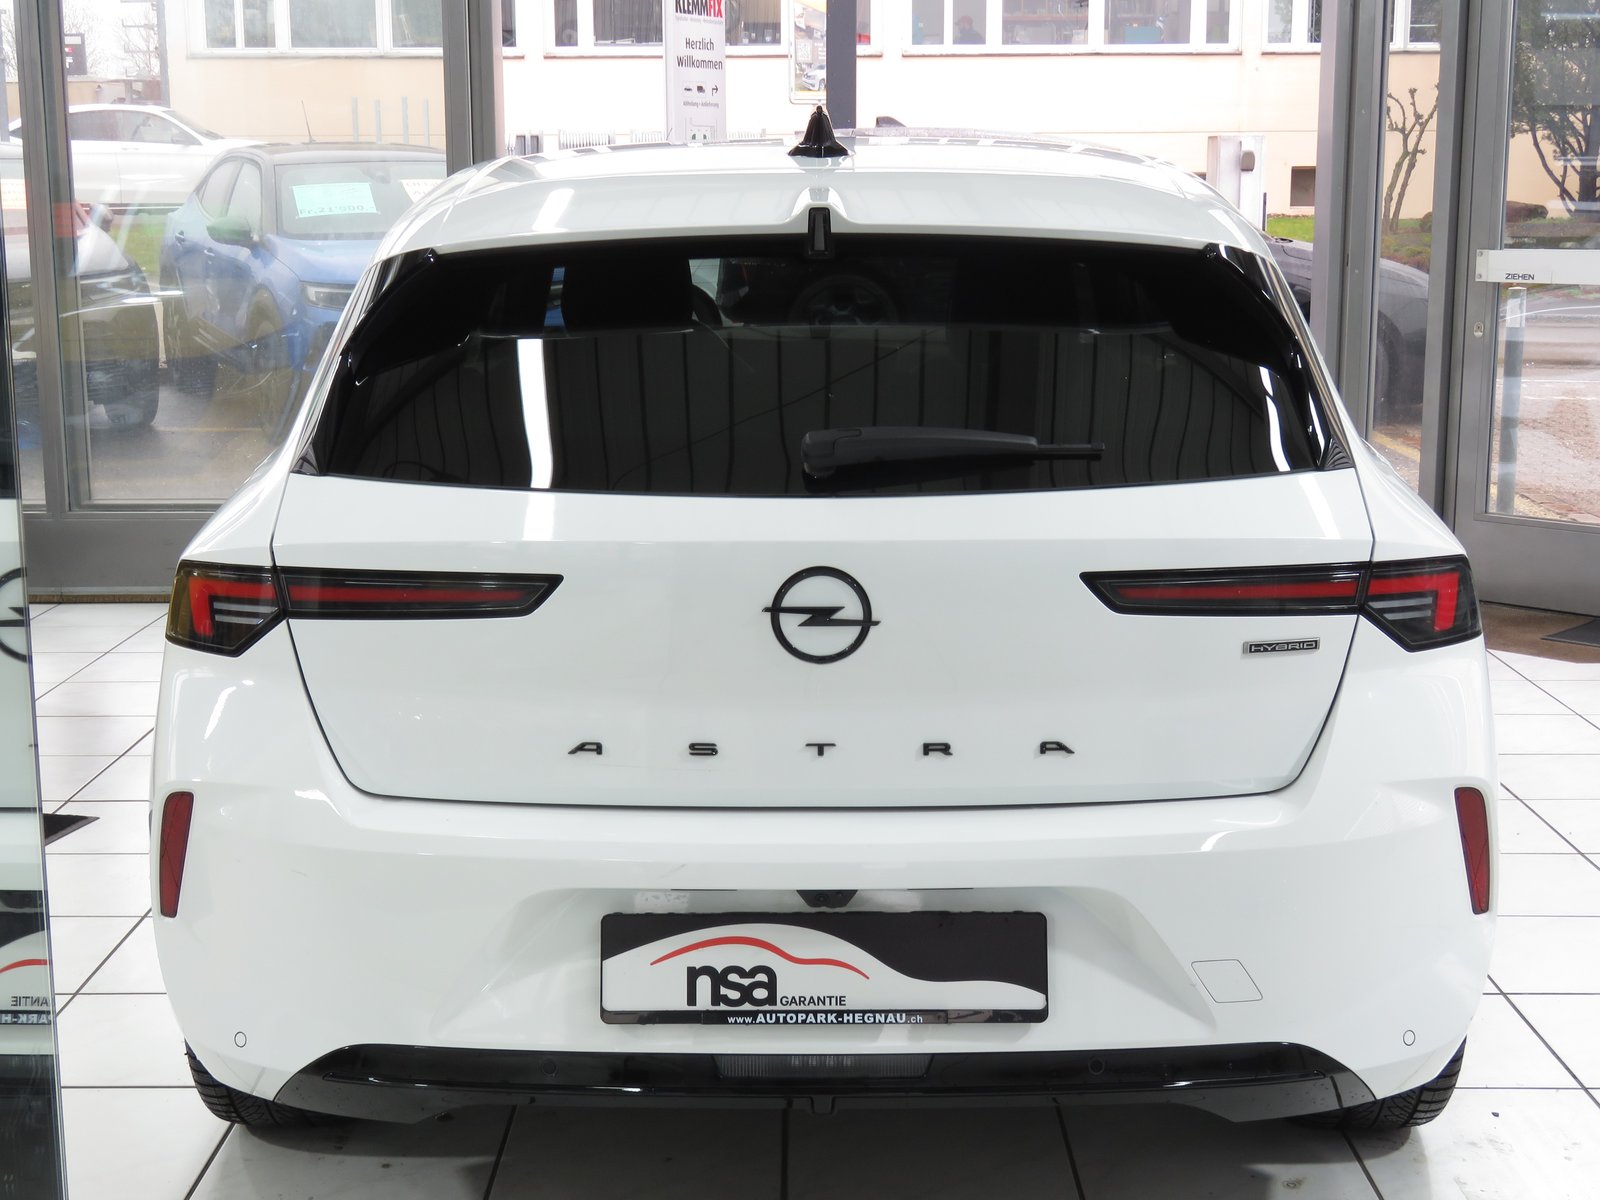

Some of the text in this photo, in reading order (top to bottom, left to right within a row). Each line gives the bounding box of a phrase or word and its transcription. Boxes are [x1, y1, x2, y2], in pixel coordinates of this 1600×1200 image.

[674, 0, 723, 18] KLEMMFIX
[685, 37, 715, 51] Herzlich
[676, 55, 723, 70] Willkommen
[1504, 273, 1535, 281] ZIEHEN
[1250, 641, 1316, 652] HYBRID
[568, 741, 1075, 756] ASTRA
[686, 965, 778, 1008] nsa
[779, 995, 847, 1007] GARANTIE
[727, 1012, 923, 1024] www.AUTOPARK-HEGNAU.ch
